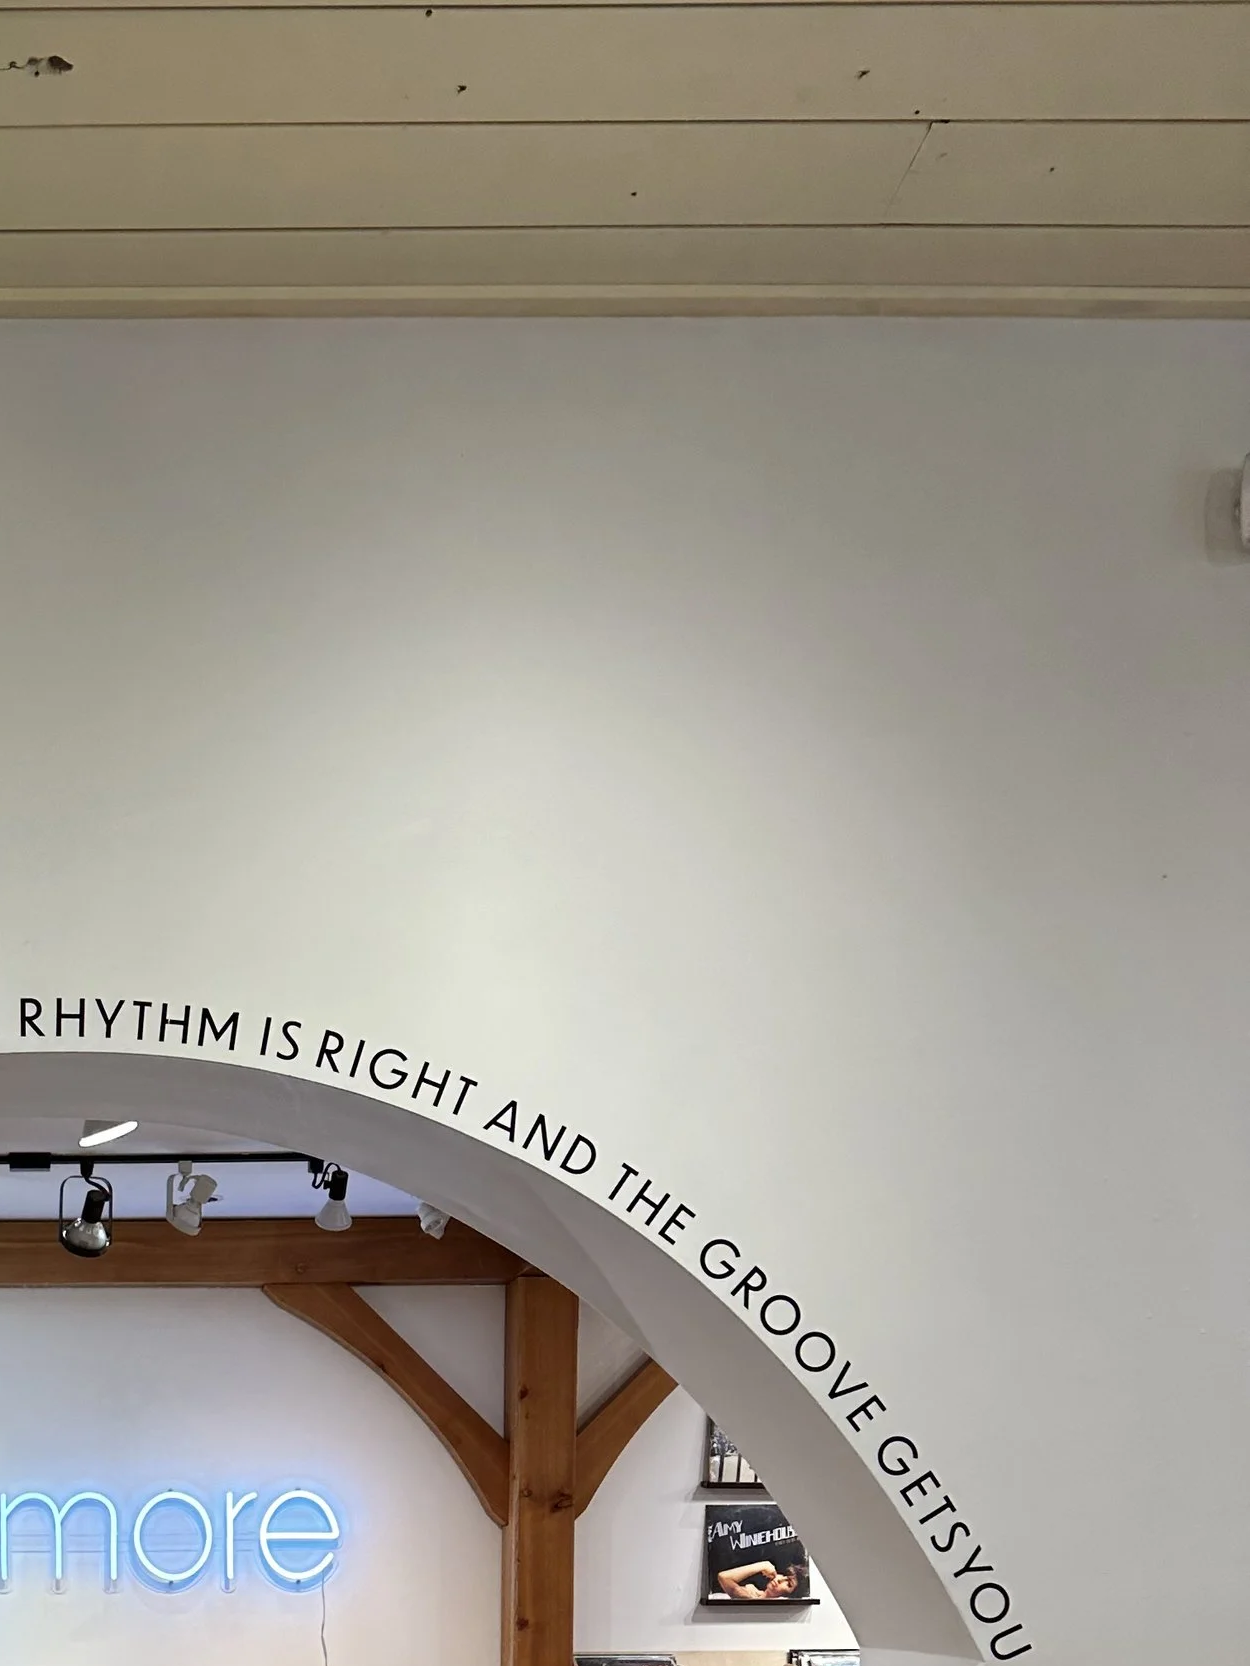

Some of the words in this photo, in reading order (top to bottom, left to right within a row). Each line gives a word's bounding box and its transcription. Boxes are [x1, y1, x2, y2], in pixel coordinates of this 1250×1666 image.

[20, 998, 240, 1050] RHYTHM
[260, 1017, 302, 1060] IS
[316, 1030, 488, 1115] RIGHT
[483, 1101, 597, 1175] AND
[609, 1163, 696, 1246] THE
[700, 1239, 887, 1433] GROOVE
[730, 1526, 798, 1551] WINEHOUS
